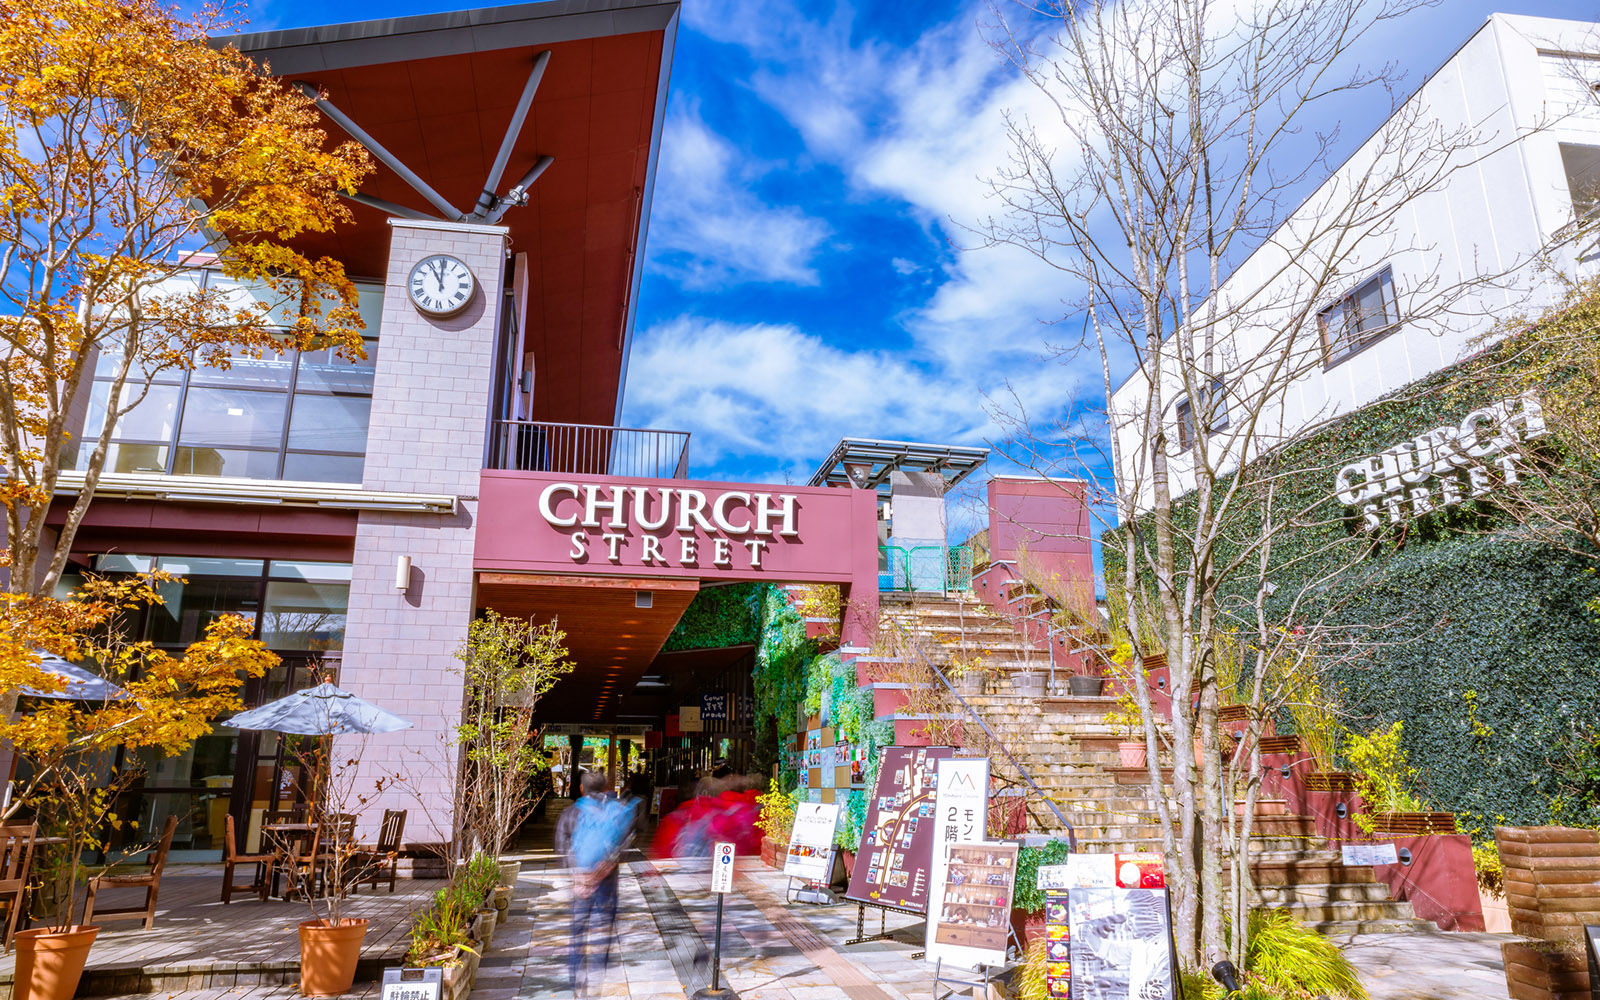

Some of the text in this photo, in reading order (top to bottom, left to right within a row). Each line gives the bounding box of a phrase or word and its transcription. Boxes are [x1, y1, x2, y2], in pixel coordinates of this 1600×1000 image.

[1335, 390, 1552, 506] CHURCH
[538, 482, 799, 536] CHURCH
[1363, 453, 1522, 533] STREET
[569, 531, 766, 566] STREET
[963, 809, 974, 841] モン
